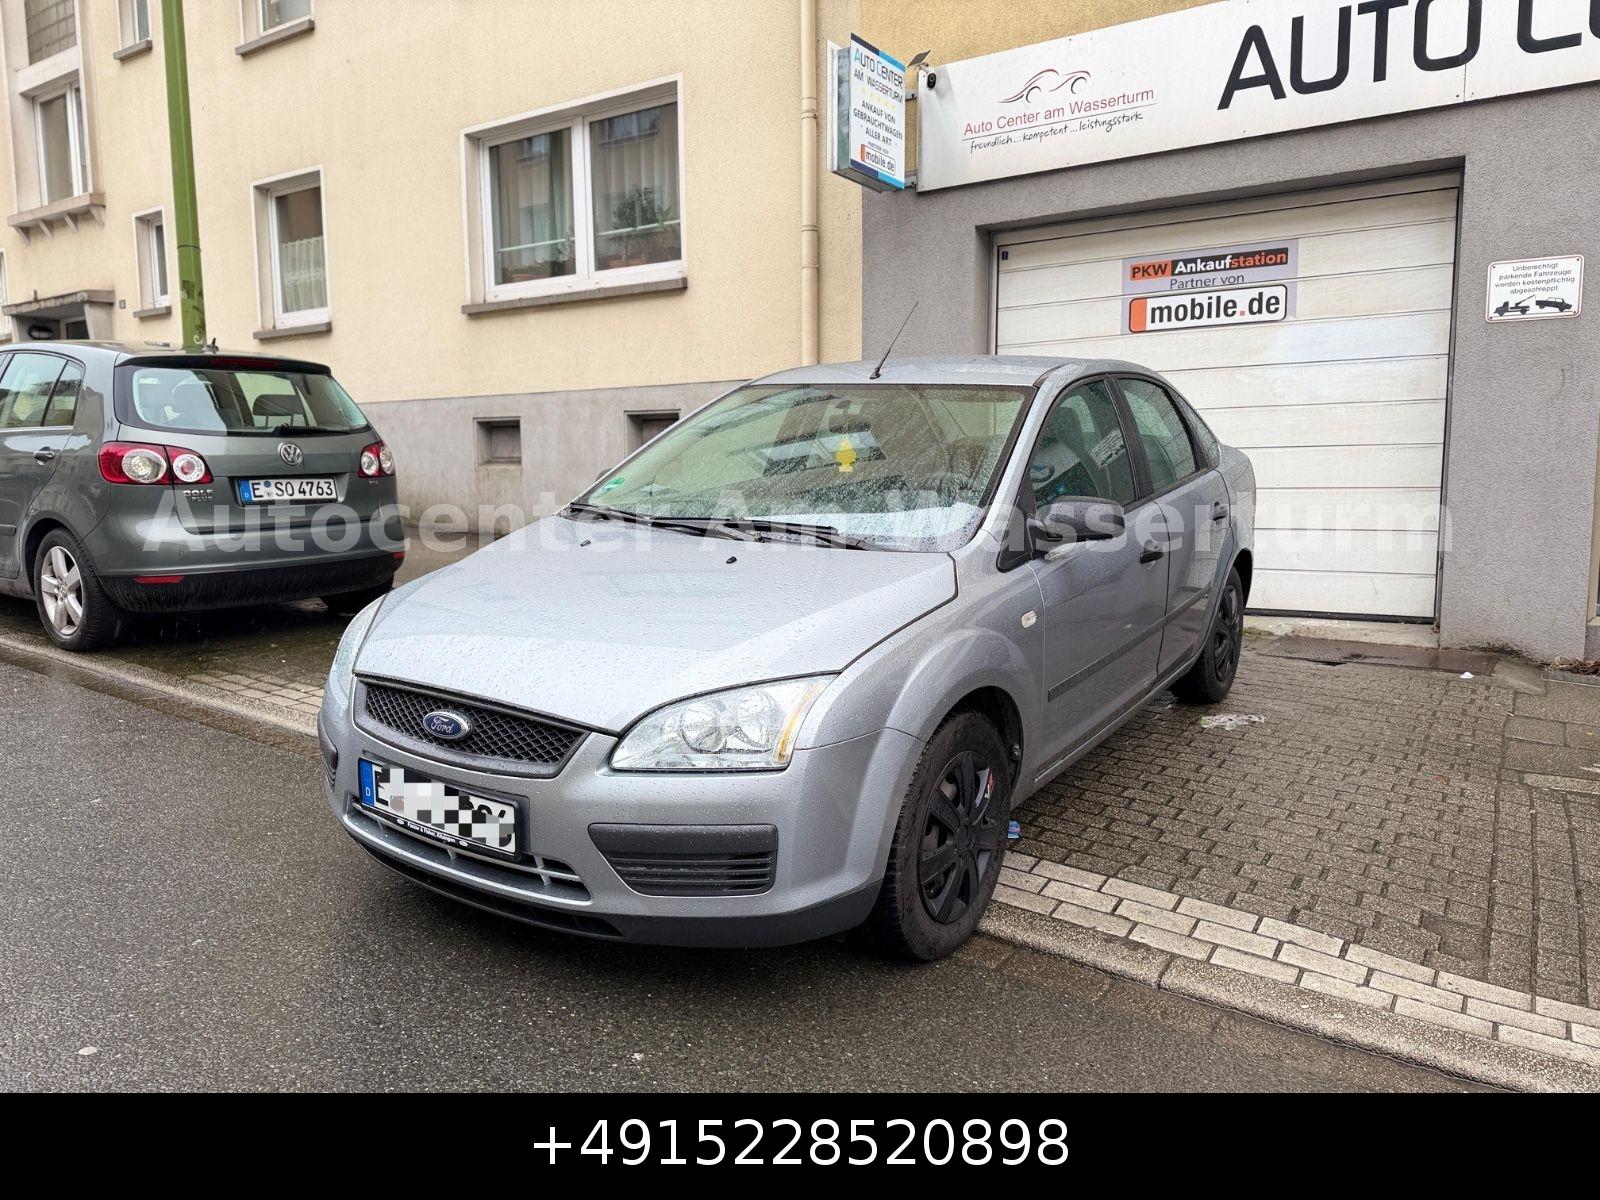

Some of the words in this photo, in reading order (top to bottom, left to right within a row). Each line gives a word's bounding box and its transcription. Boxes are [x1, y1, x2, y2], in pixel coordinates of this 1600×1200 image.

[1217, 0, 1482, 110] AUTO
[854, 47, 875, 72] AUTO
[876, 60, 903, 89] CENTER
[853, 68, 864, 82] AM
[866, 74, 903, 103] WASSERTURM
[861, 100, 884, 117] ANKAUF
[884, 111, 896, 124] VON
[964, 122, 993, 136] Auto
[996, 111, 1040, 129] Center
[1044, 106, 1065, 119] am
[1069, 89, 1154, 115] Wasserturm
[853, 107, 903, 140] GEBRAUCHTWAGEN
[865, 127, 881, 141] ALLER
[881, 135, 892, 146] ART
[865, 151, 895, 172] mobile.de
[1132, 262, 1168, 278] PKW
[1174, 252, 1287, 275] Ankaufstation
[1498, 272, 1532, 281] parkende
[1533, 269, 1572, 277] Fahrzeuge
[1512, 262, 1559, 271] Unberechtigt
[1170, 277, 1217, 290] Partner
[1220, 274, 1245, 284] von
[1494, 280, 1521, 288] werden
[1522, 276, 1576, 286] kostenpflichtig
[1510, 285, 1559, 294] abgeschleppt
[1150, 291, 1280, 324] mobile.de
[251, 481, 264, 498] E
[275, 481, 295, 497] SO
[298, 480, 333, 497] 4763
[431, 715, 455, 733] Ford
